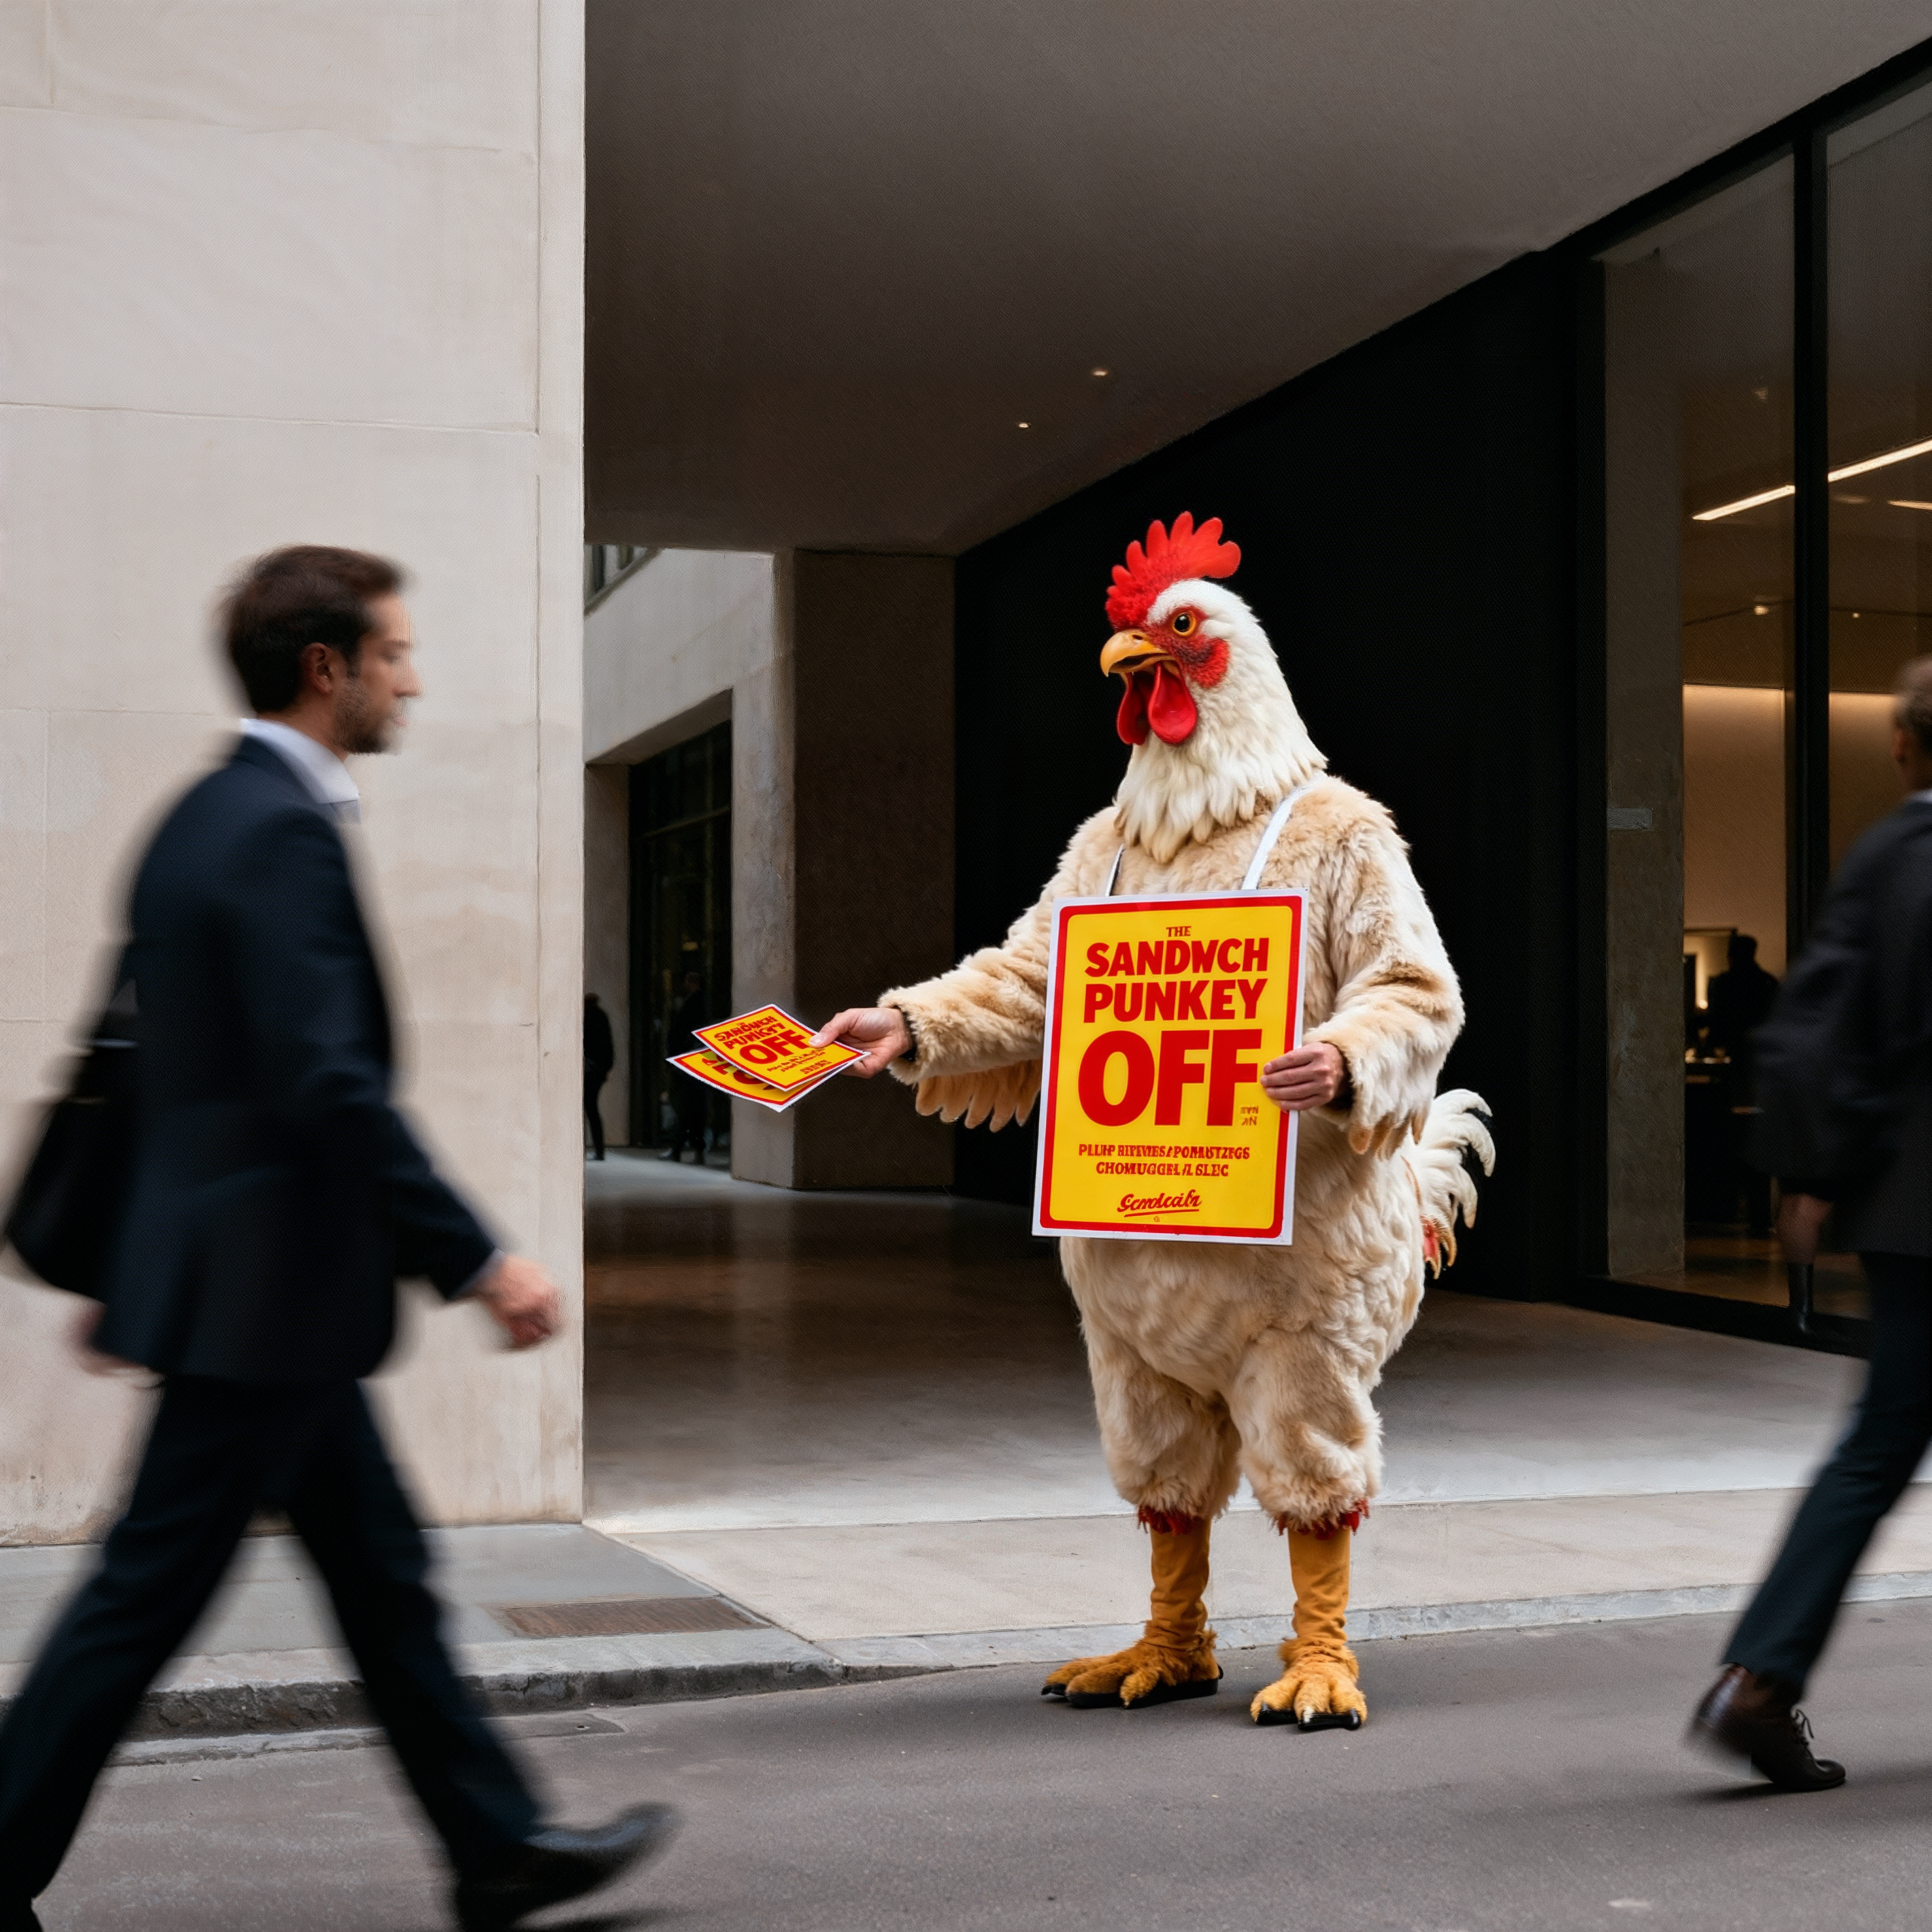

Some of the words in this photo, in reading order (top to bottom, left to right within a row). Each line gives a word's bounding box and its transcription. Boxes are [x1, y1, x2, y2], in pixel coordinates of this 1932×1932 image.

[1166, 926, 1192, 937] THE
[1084, 937, 1269, 978] SANDWCH
[1083, 978, 1269, 1023] PUNKEY
[739, 1029, 810, 1065] OFF
[1078, 1029, 1263, 1127] OFF
